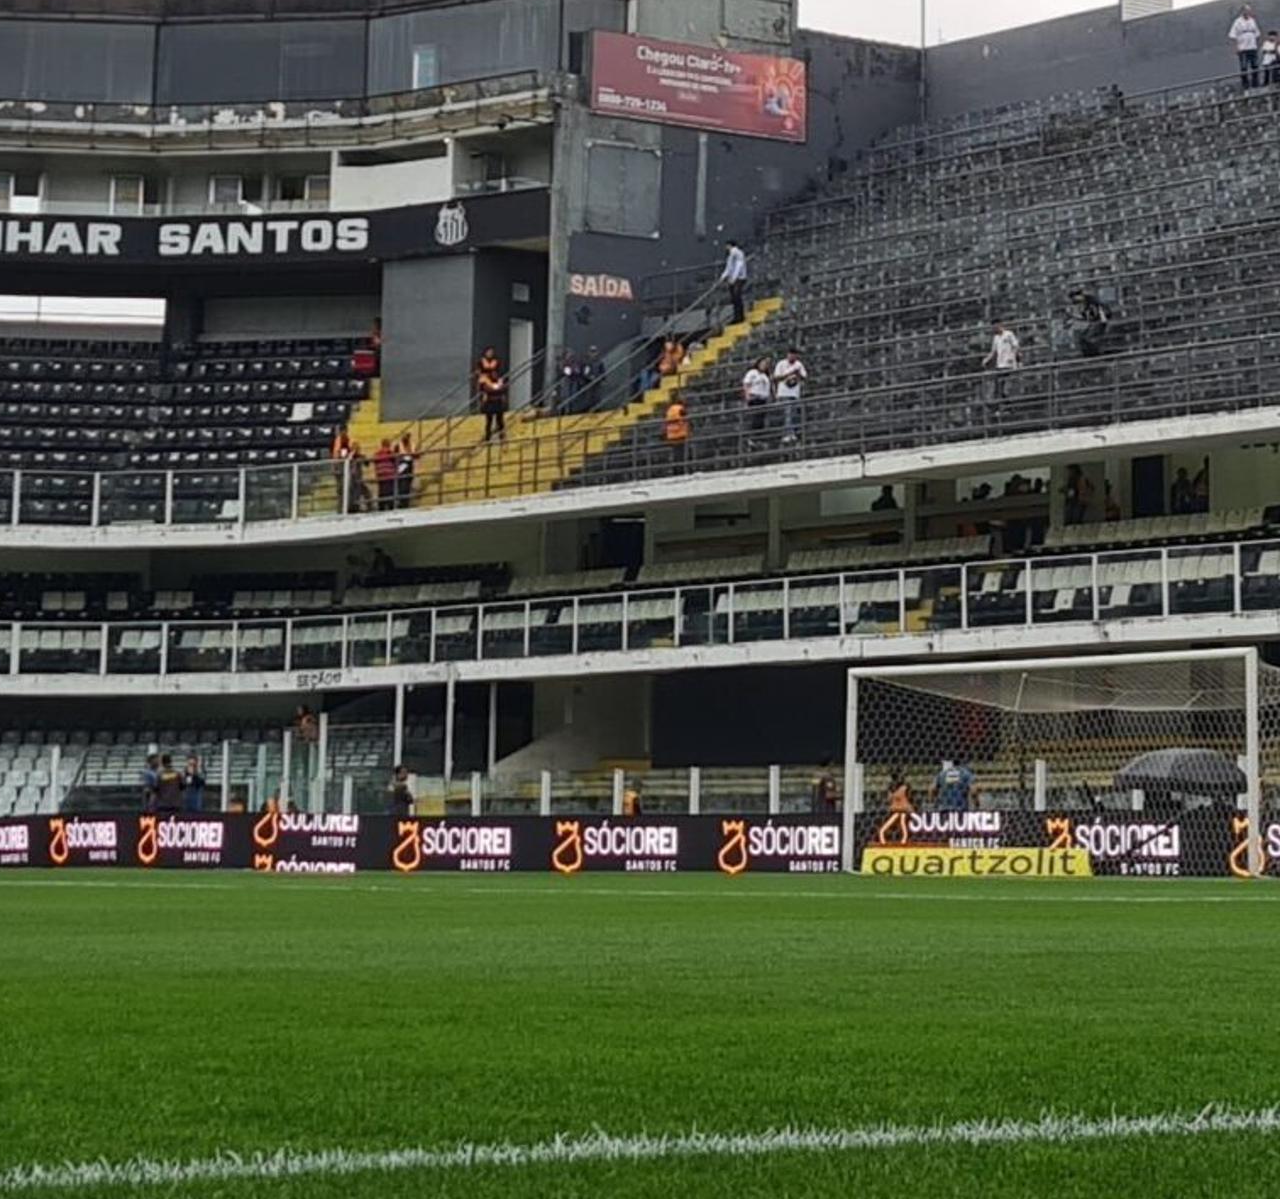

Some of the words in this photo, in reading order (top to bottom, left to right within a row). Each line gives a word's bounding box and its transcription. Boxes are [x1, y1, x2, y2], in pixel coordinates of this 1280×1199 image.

[637, 45, 686, 67] Chegou
[157, 216, 371, 256] SANTOS
[570, 272, 633, 299] SAÍDA
[158, 816, 224, 848] SÓCIOREI
[422, 820, 511, 855] SÓCIOREI
[584, 820, 678, 855] SÓCIOREI
[749, 819, 840, 855] SÓCIOREI
